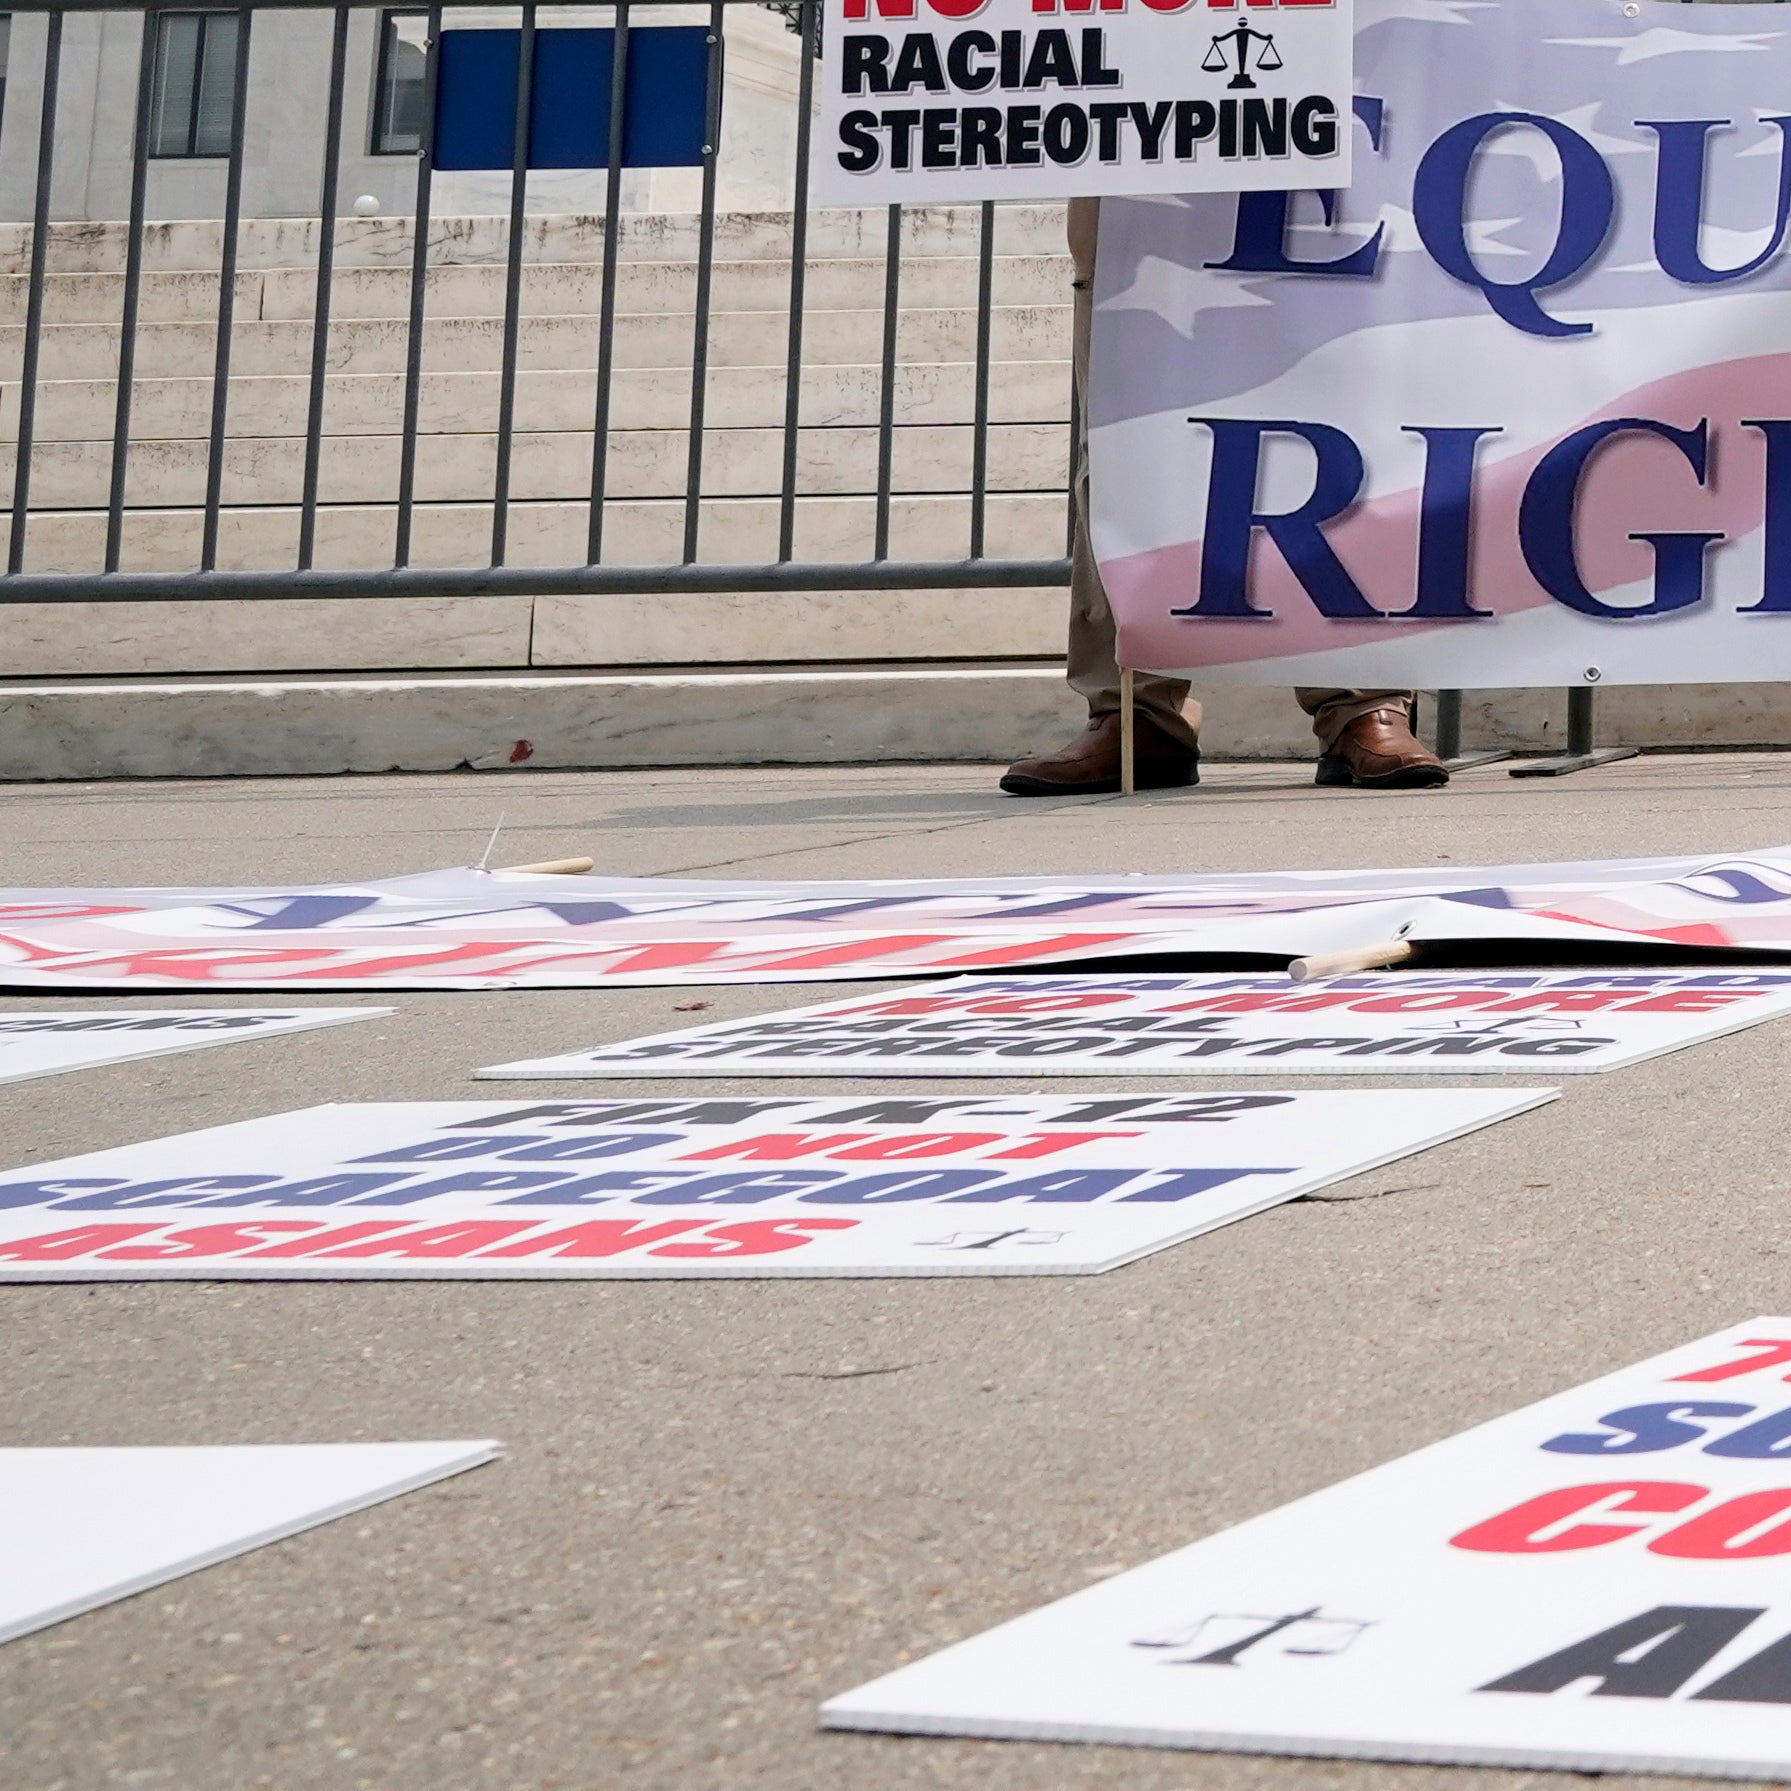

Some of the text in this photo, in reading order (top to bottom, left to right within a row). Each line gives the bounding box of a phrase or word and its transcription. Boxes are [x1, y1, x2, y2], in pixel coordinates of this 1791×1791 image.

[841, 27, 1121, 94] RACIAL
[837, 95, 1338, 173] STEREOTYPING
[804, 989, 1771, 1018] NO MORE
[705, 1015, 1255, 1037] RACIAL
[590, 1035, 1618, 1061] STEREOTYPING
[435, 1095, 1296, 1130] FIX K-12
[334, 1131, 1143, 1165] DO NOT
[0, 1167, 1305, 1212] SCAPEGOAT
[0, 1217, 862, 1262] ASIANS
